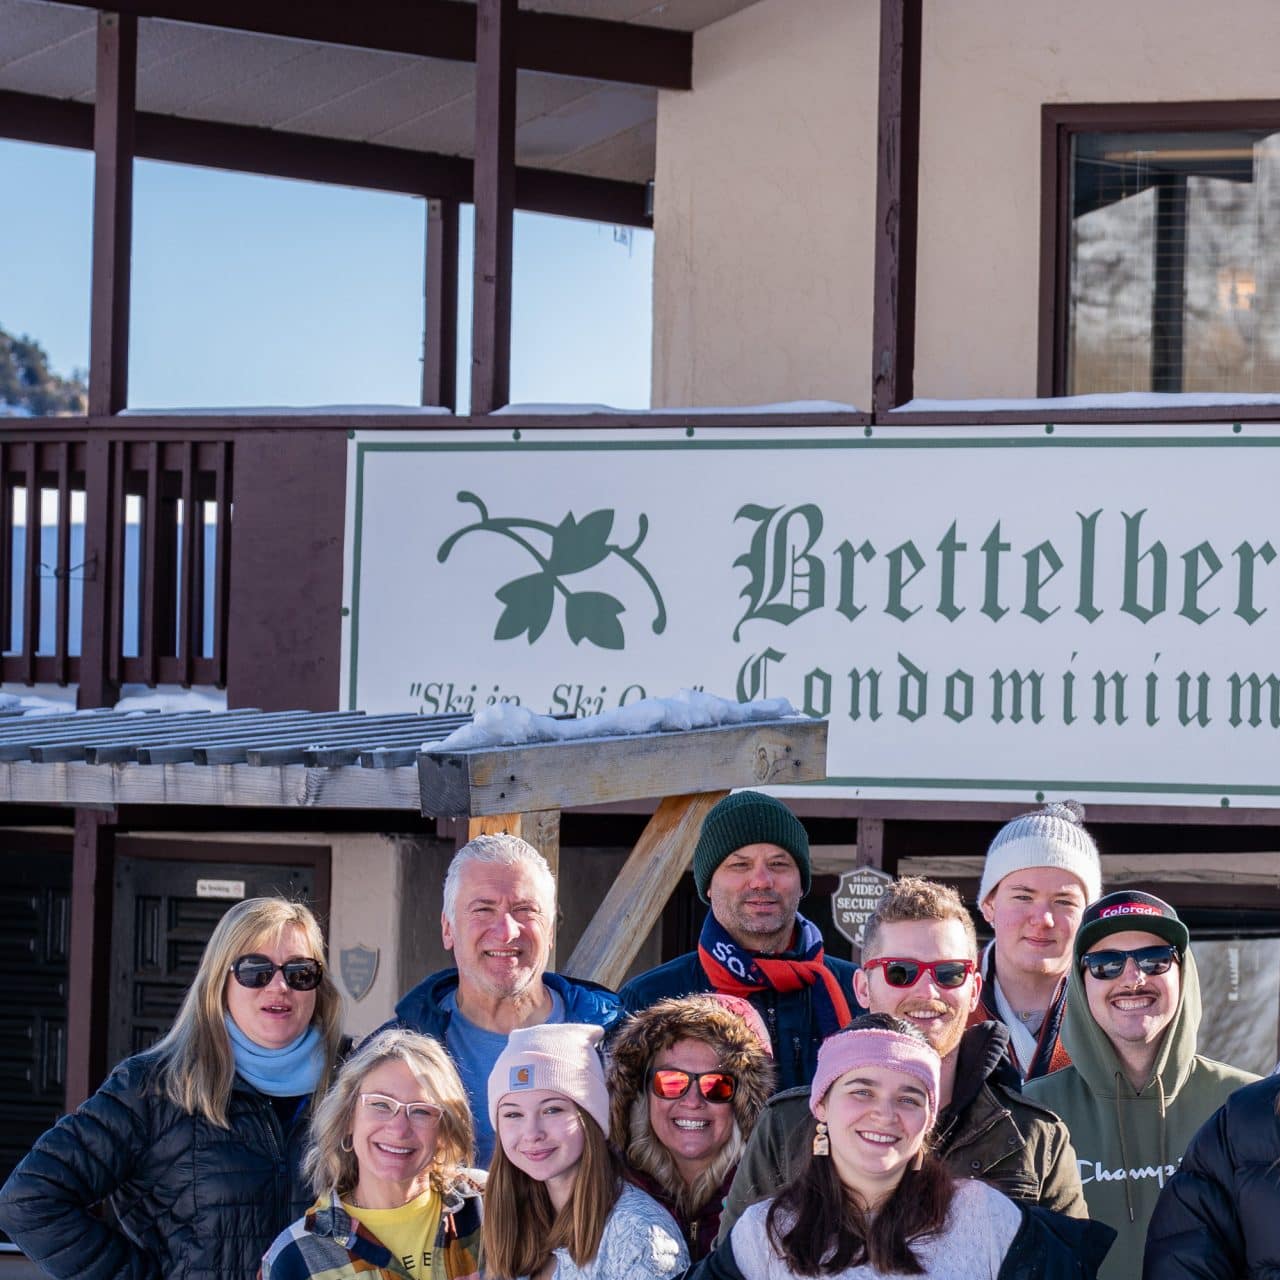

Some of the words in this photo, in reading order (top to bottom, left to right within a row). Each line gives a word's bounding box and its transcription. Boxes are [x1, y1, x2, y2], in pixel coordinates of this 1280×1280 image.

[848, 883, 884, 896] VIDEO
[842, 912, 871, 923] SYST
[1076, 1157, 1184, 1189] Champ
